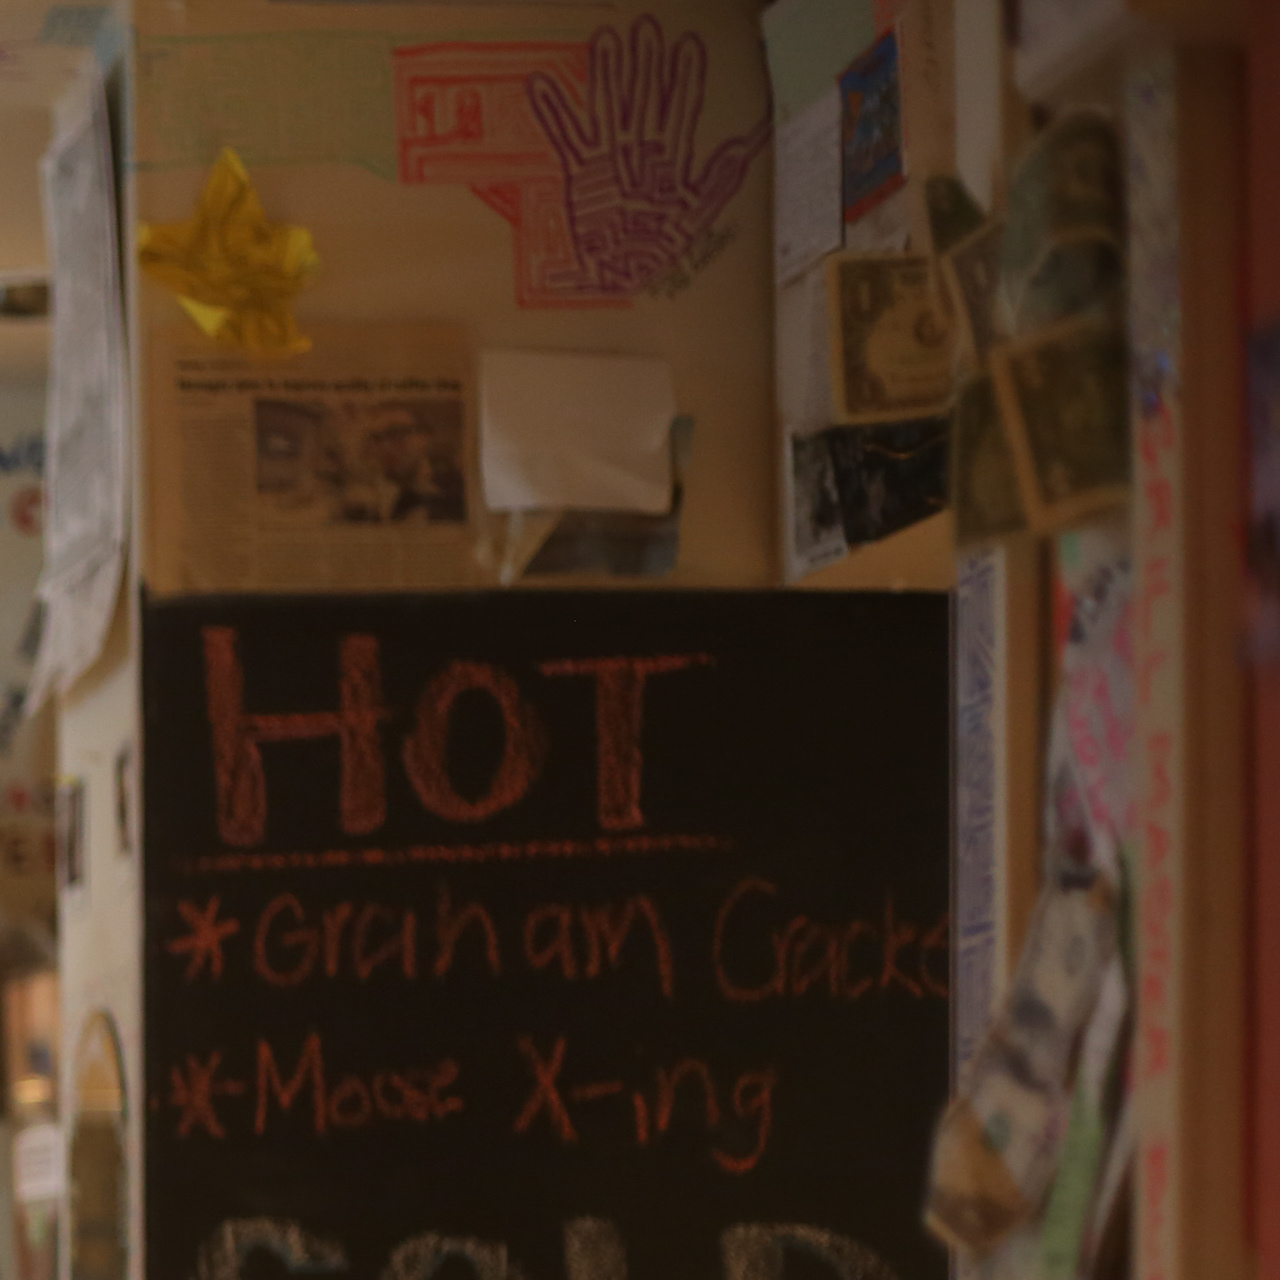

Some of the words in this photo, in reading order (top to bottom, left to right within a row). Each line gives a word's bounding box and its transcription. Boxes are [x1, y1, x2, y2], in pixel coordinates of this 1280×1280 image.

[200, 624, 716, 846] HOT
[253, 890, 674, 998] Graham
[513, 1036, 776, 1173] X-ing
